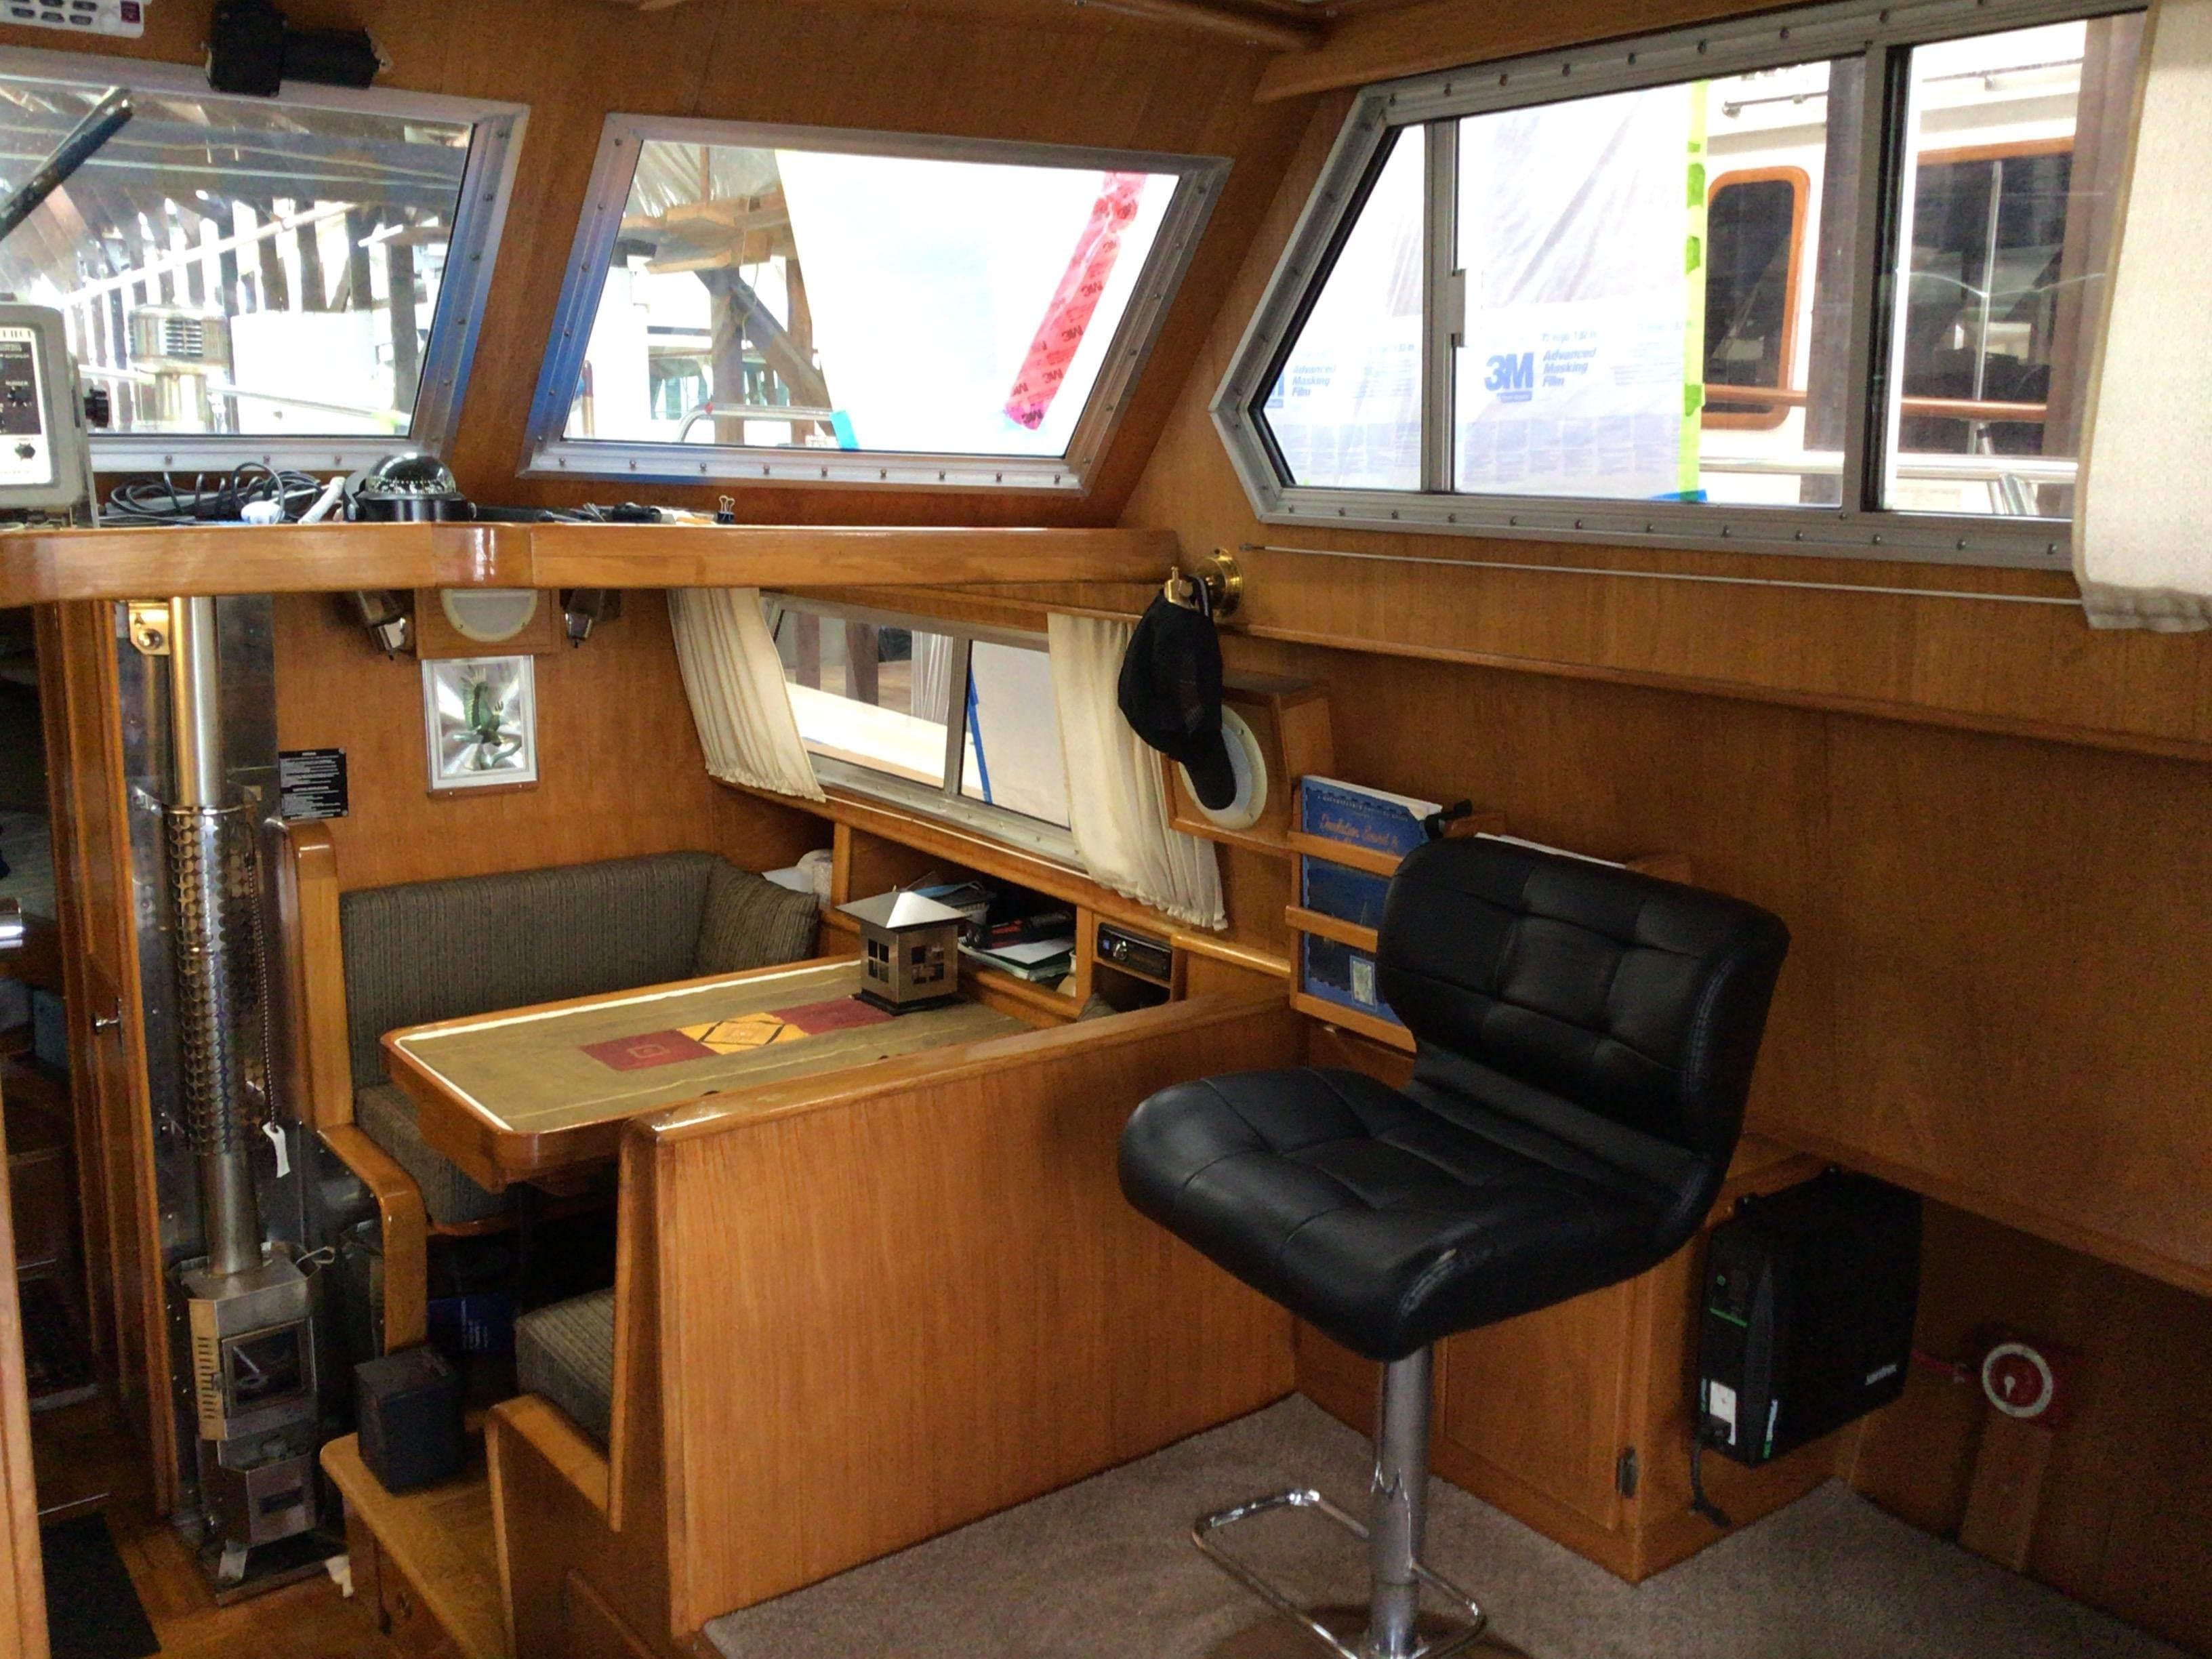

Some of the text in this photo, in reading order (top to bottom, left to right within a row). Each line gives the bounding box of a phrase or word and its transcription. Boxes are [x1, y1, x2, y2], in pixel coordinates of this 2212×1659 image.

[1542, 347, 1597, 362] Advanced
[1484, 351, 1535, 392] 3M
[1542, 362, 1589, 375] Masking
[1292, 375, 1331, 387] Masking
[1542, 375, 1565, 387] Film
[1291, 387, 1312, 397] Film
